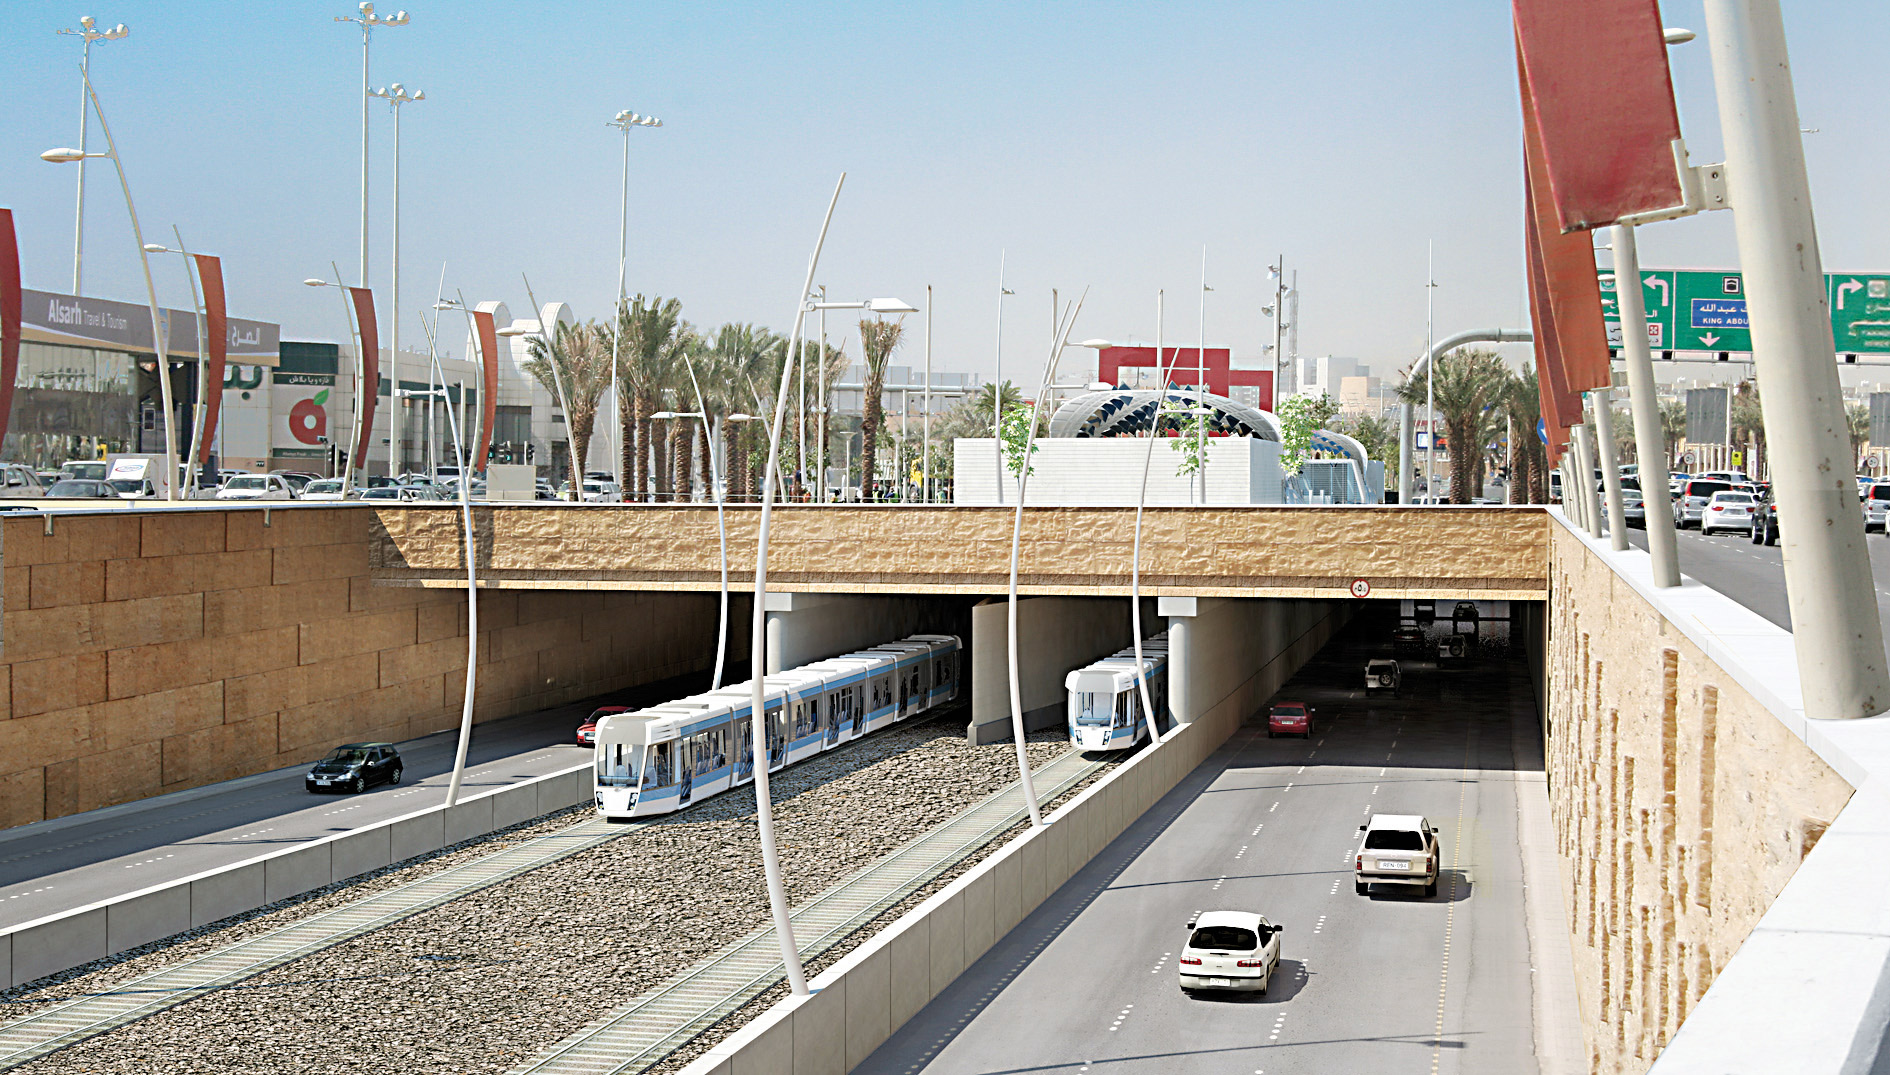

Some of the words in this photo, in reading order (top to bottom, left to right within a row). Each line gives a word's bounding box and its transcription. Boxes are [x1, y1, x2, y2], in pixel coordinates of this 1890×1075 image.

[48, 299, 82, 325] Alsarh
[83, 310, 101, 327] Travel
[101, 312, 106, 327] &
[107, 313, 127, 330] Tourism
[1702, 317, 1722, 325] KING
